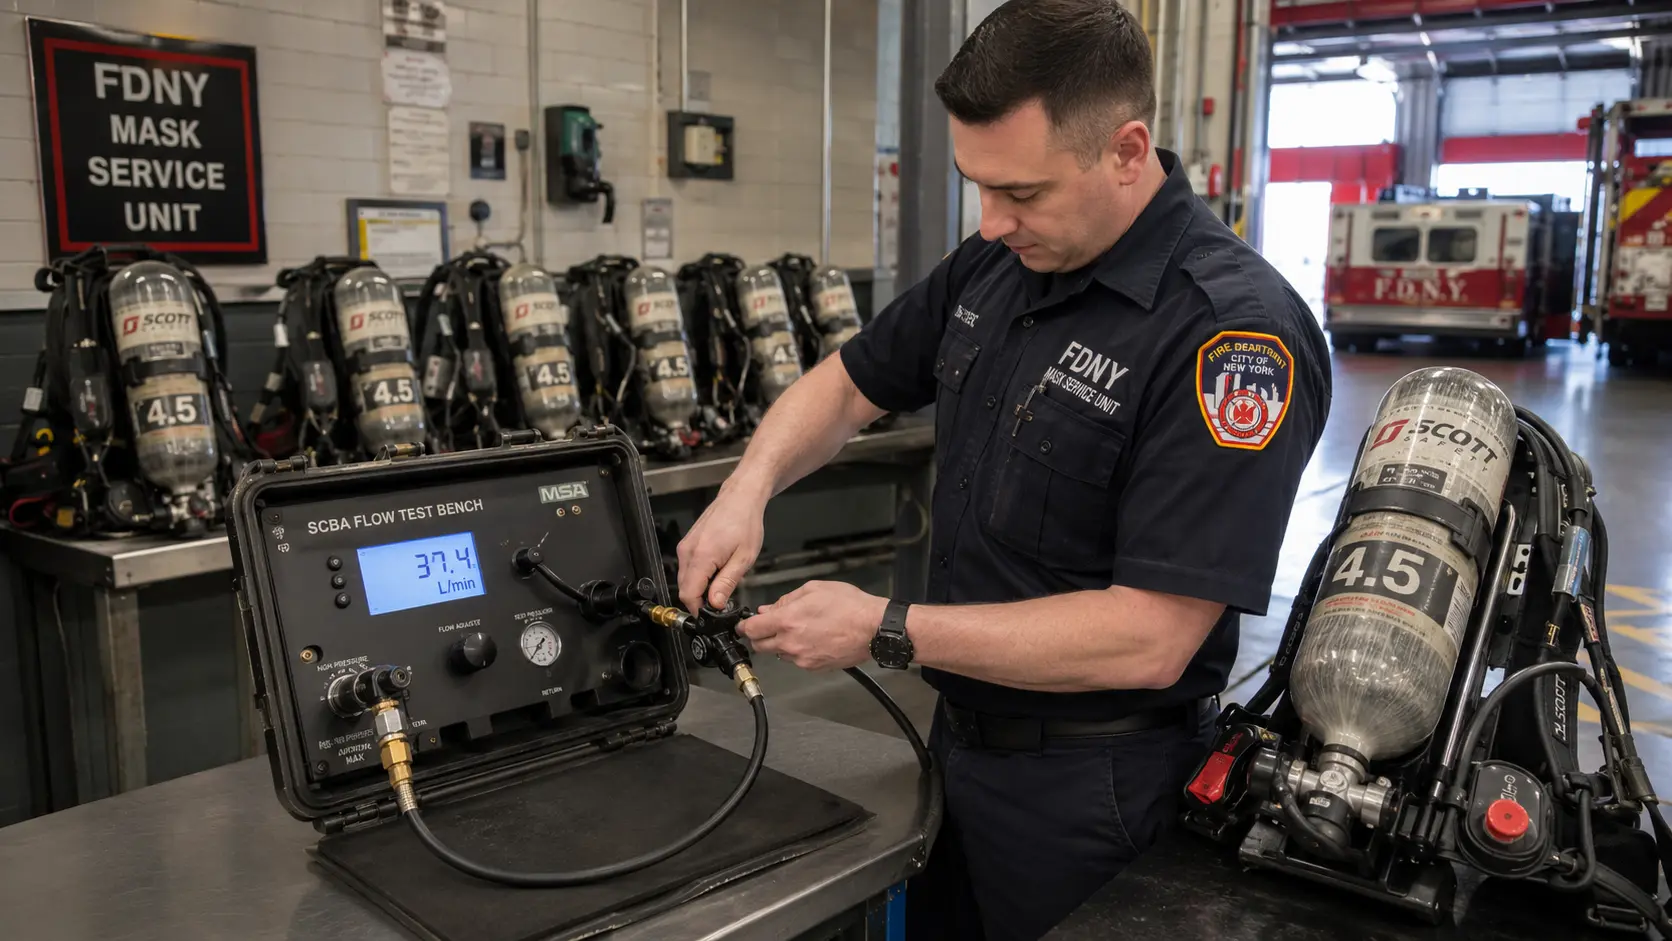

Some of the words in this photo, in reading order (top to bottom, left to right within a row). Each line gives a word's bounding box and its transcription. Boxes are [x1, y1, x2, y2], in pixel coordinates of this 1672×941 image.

[94, 62, 209, 107] FDNY
[110, 114, 202, 149] MASK
[88, 156, 225, 190] SERVICE
[125, 201, 201, 231] UNIT
[143, 313, 191, 325] SCOTT
[1057, 340, 1130, 391] FDNY
[1207, 342, 1233, 363] FIRE
[1231, 354, 1254, 363] CITY
[1256, 356, 1269, 365] OF
[537, 363, 571, 385] 4.5
[658, 356, 689, 377] 4.5
[1223, 363, 1246, 373] NEW
[1248, 365, 1275, 376] YORK
[374, 379, 413, 404] 4.5
[1094, 392, 1121, 416] UNIT
[147, 396, 197, 425] 4.5
[1408, 419, 1499, 465] SCOTT
[540, 486, 588, 503] MSA
[307, 517, 352, 535] SCBA
[353, 510, 396, 529] FLOW
[398, 505, 434, 523] TEST
[436, 498, 485, 518] BENCH
[414, 546, 475, 580] 37.4
[1331, 546, 1425, 596] 4.5
[437, 578, 477, 596] L/min
